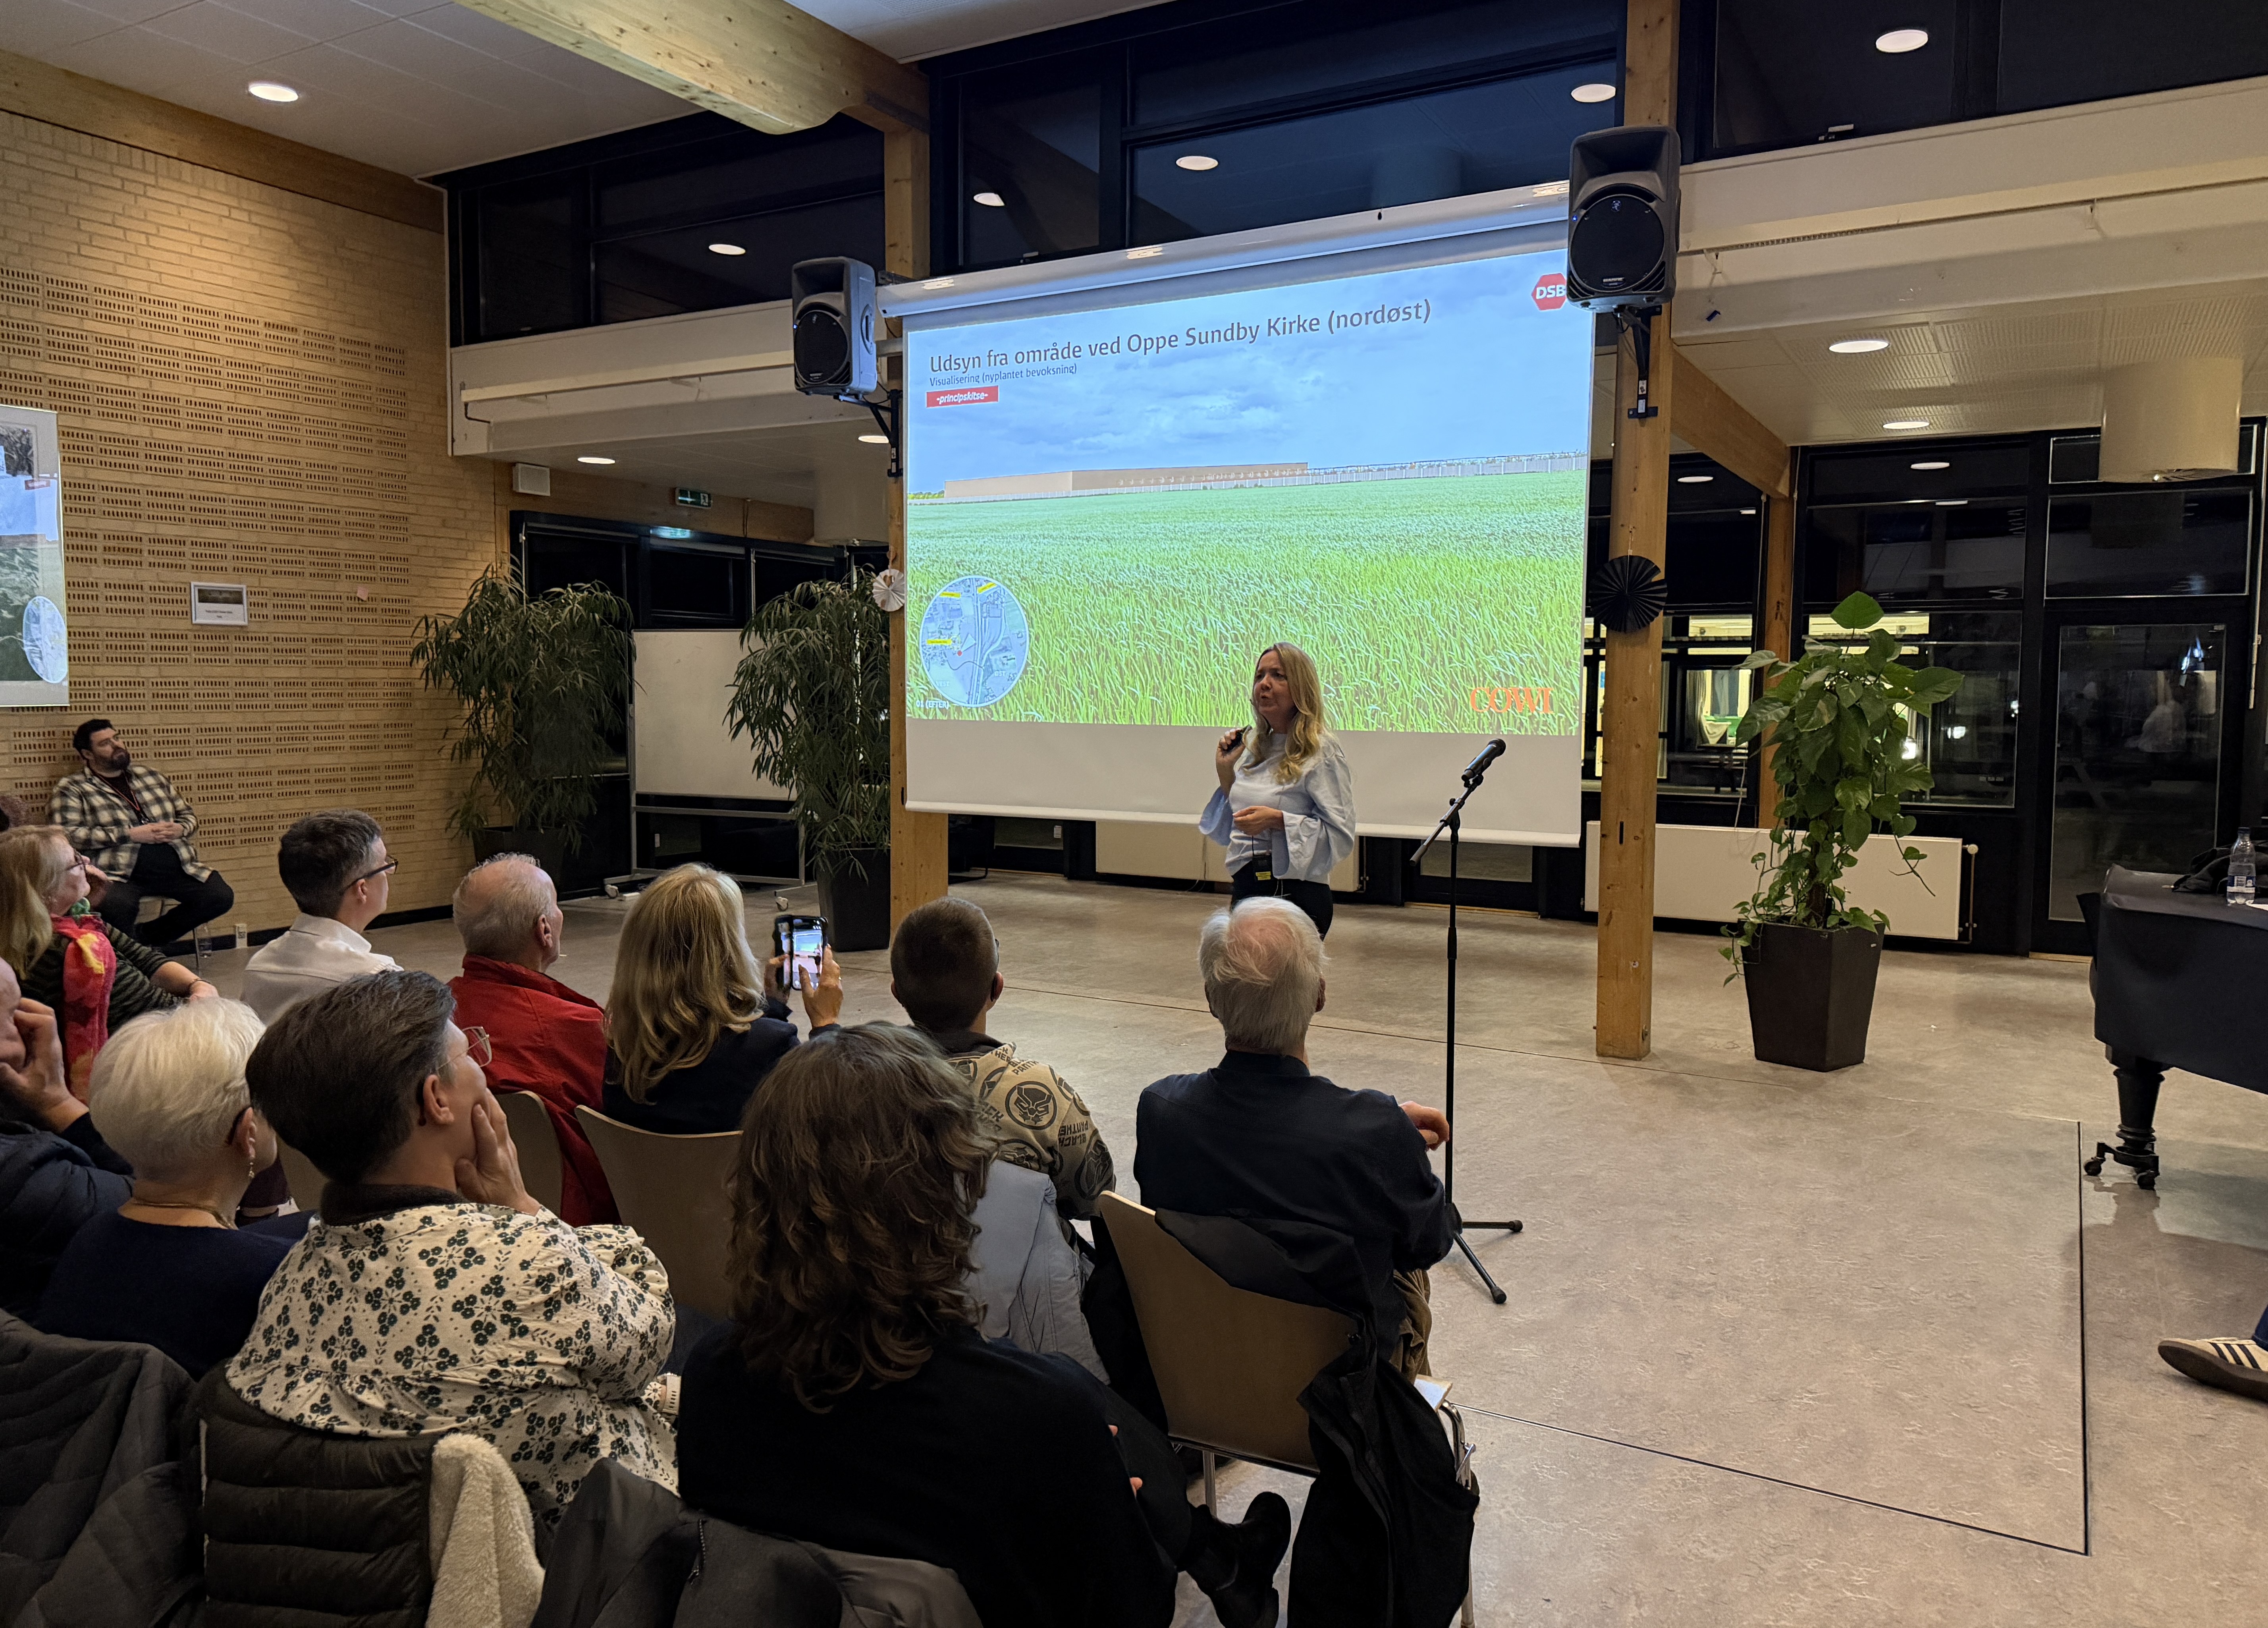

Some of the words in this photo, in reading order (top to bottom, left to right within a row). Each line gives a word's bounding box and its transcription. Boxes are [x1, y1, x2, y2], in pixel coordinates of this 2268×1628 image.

[1536, 285, 1566, 299] DSB
[931, 355, 982, 375] Udsyn
[987, 350, 1008, 367] fra
[1015, 342, 1082, 364] område
[1088, 336, 1120, 356] ved
[1127, 334, 1178, 355] Oppe
[1185, 323, 1259, 346] Sundby
[1267, 315, 1320, 337] Kirke
[1328, 299, 1431, 334] (nordøst)
[930, 374, 980, 386] Visualisering
[982, 369, 1023, 383] (nyplantet
[1026, 363, 1077, 378] bevoksning)
[926, 700, 949, 710] (EFTER)
[1470, 687, 1554, 713] COWI
